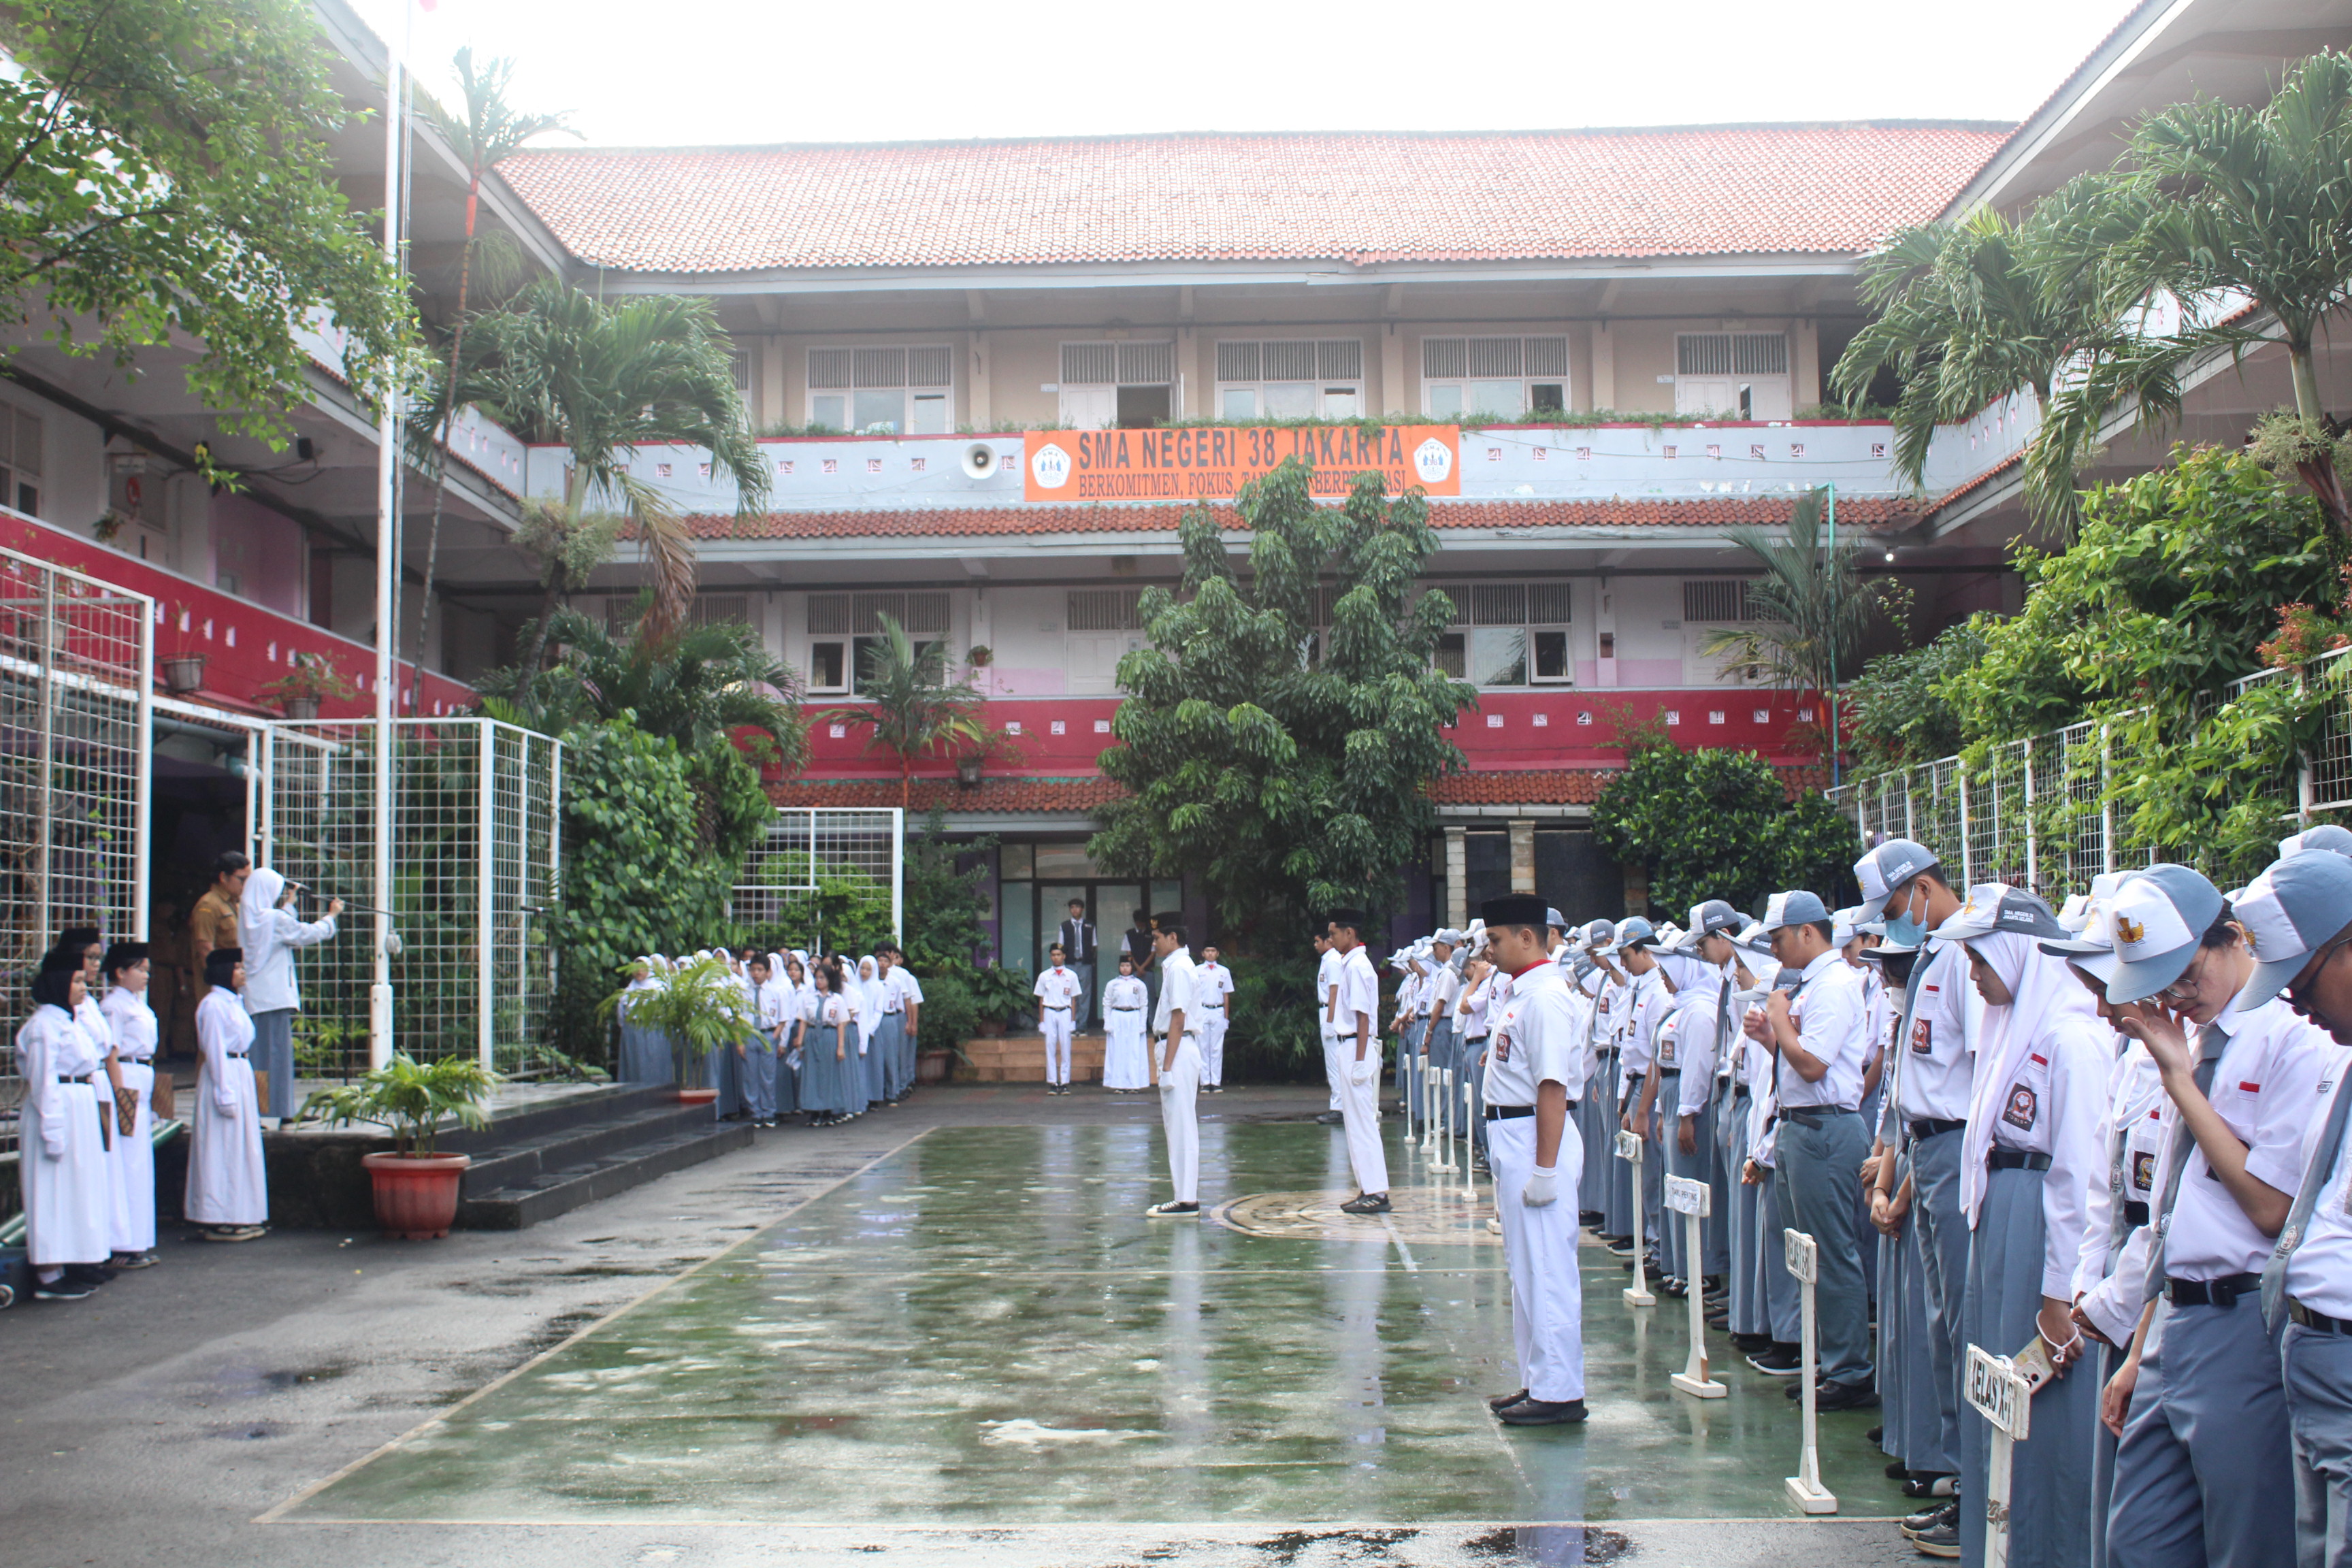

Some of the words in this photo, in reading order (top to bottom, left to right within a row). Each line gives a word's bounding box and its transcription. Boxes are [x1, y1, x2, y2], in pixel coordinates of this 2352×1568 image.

[1079, 432, 1130, 469] SMA
[1142, 429, 1235, 468] NEGERI
[1248, 429, 1275, 467] 38
[1293, 428, 1404, 466] JAKARTA
[1079, 472, 1183, 497] BERKOMITMEN,
